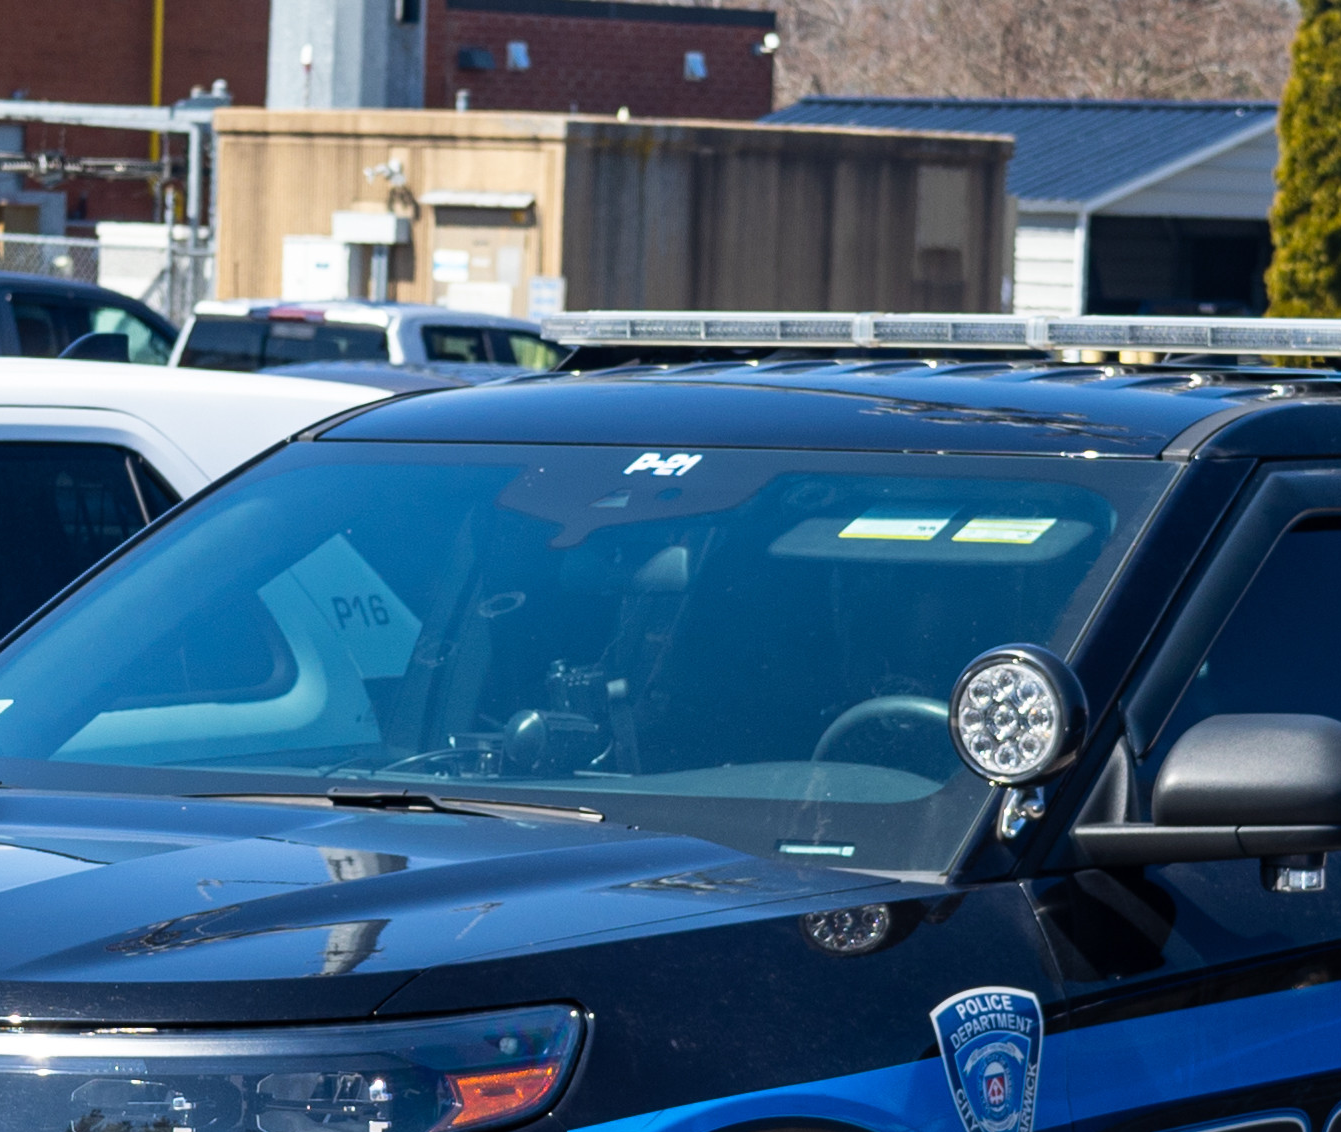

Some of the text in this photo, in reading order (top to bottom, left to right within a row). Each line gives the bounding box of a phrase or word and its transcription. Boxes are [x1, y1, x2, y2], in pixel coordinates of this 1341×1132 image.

[623, 452, 703, 476] P-21
[331, 594, 391, 630] P16
[955, 995, 1013, 1020] POLICE
[950, 1013, 1033, 1049] DEPARTMENT
[955, 1088, 980, 1131] CITY
